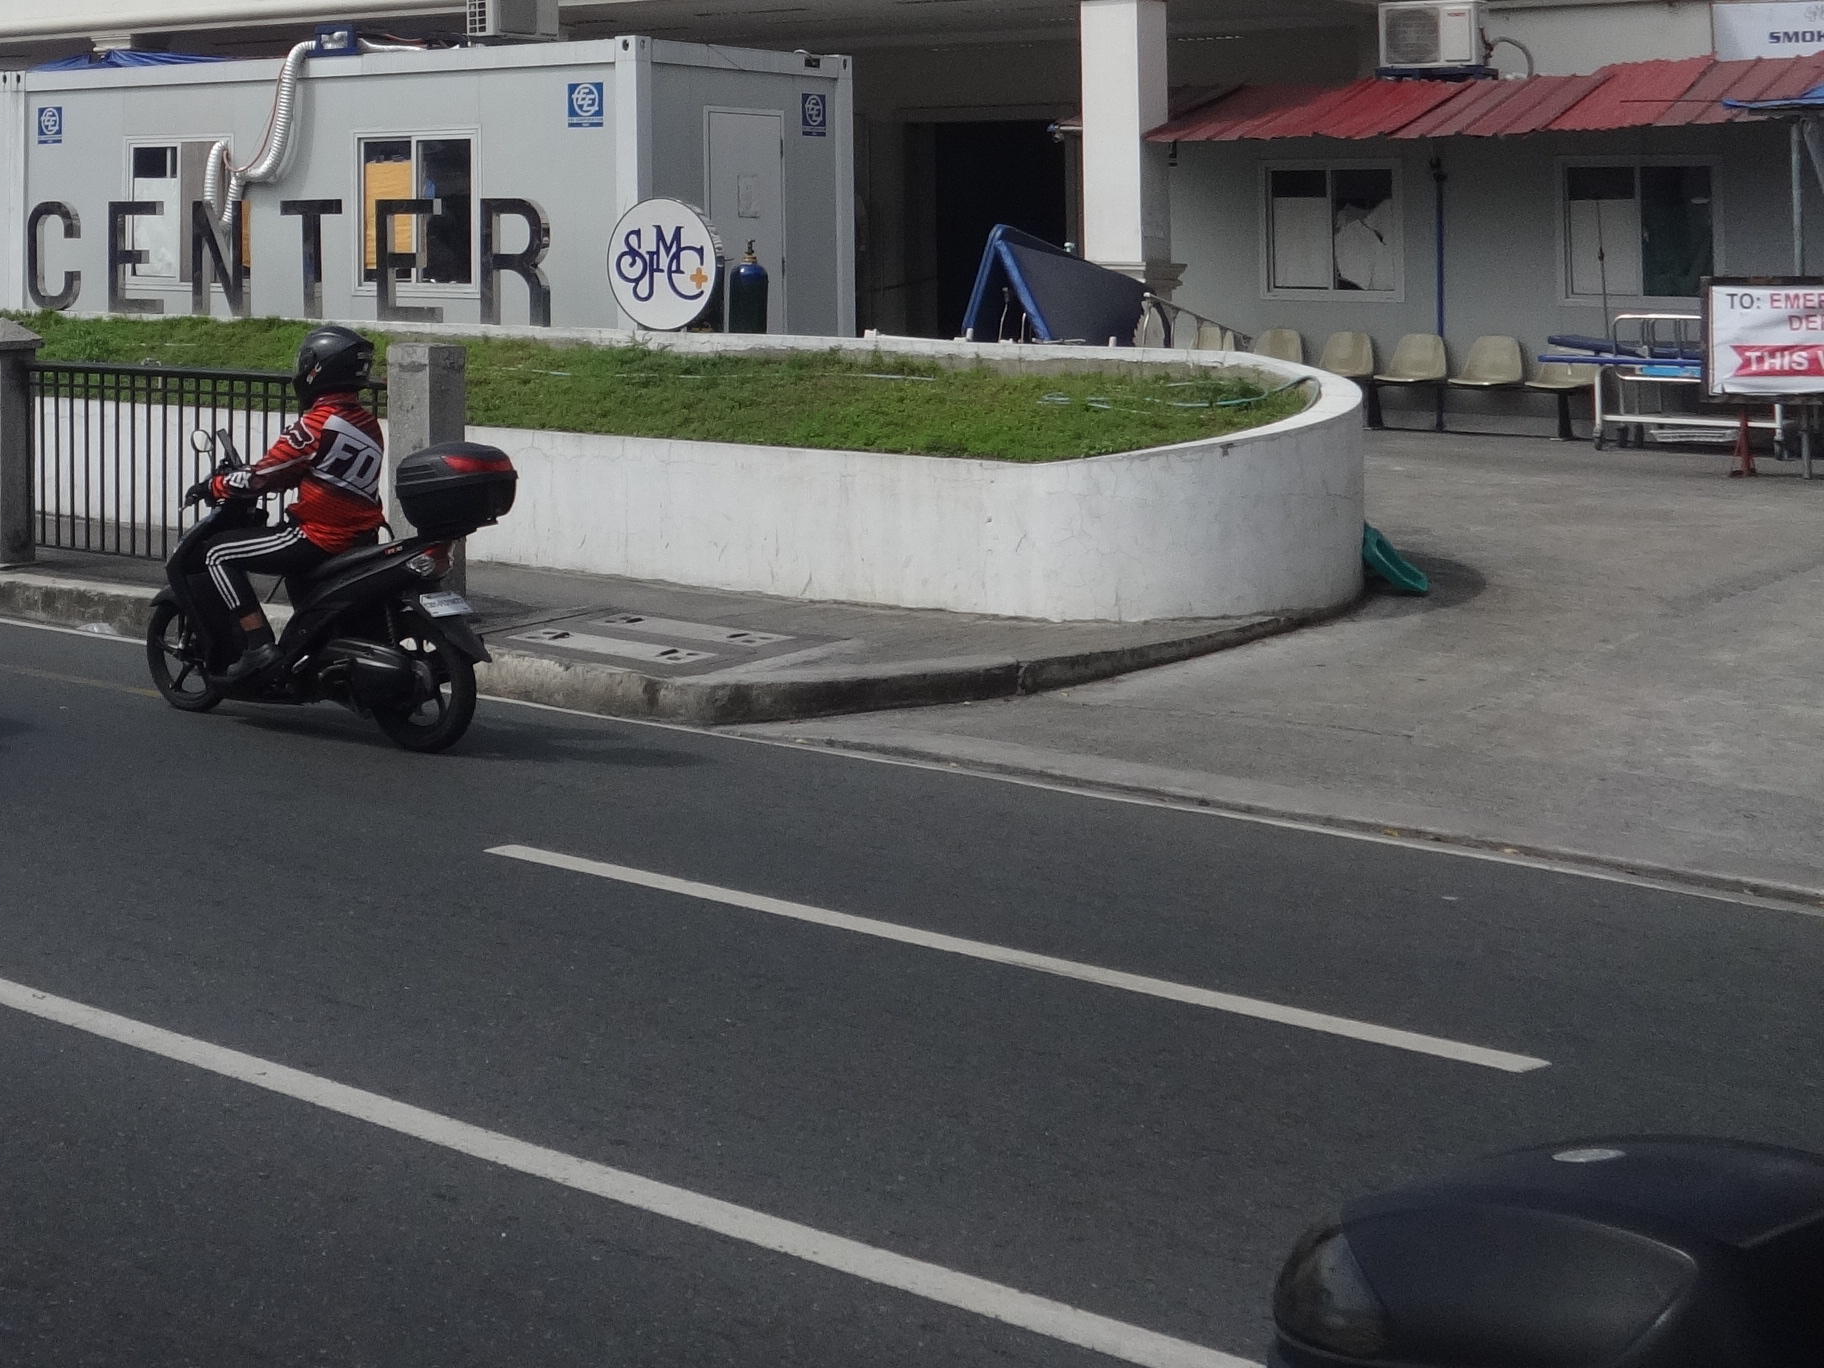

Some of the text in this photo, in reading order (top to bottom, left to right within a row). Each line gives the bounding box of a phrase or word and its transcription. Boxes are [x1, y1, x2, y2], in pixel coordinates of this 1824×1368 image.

[27, 198, 552, 327] CENTER
[1725, 292, 1762, 310] TO:
[1788, 314, 1824, 332] DE
[1744, 350, 1811, 372] THIS
